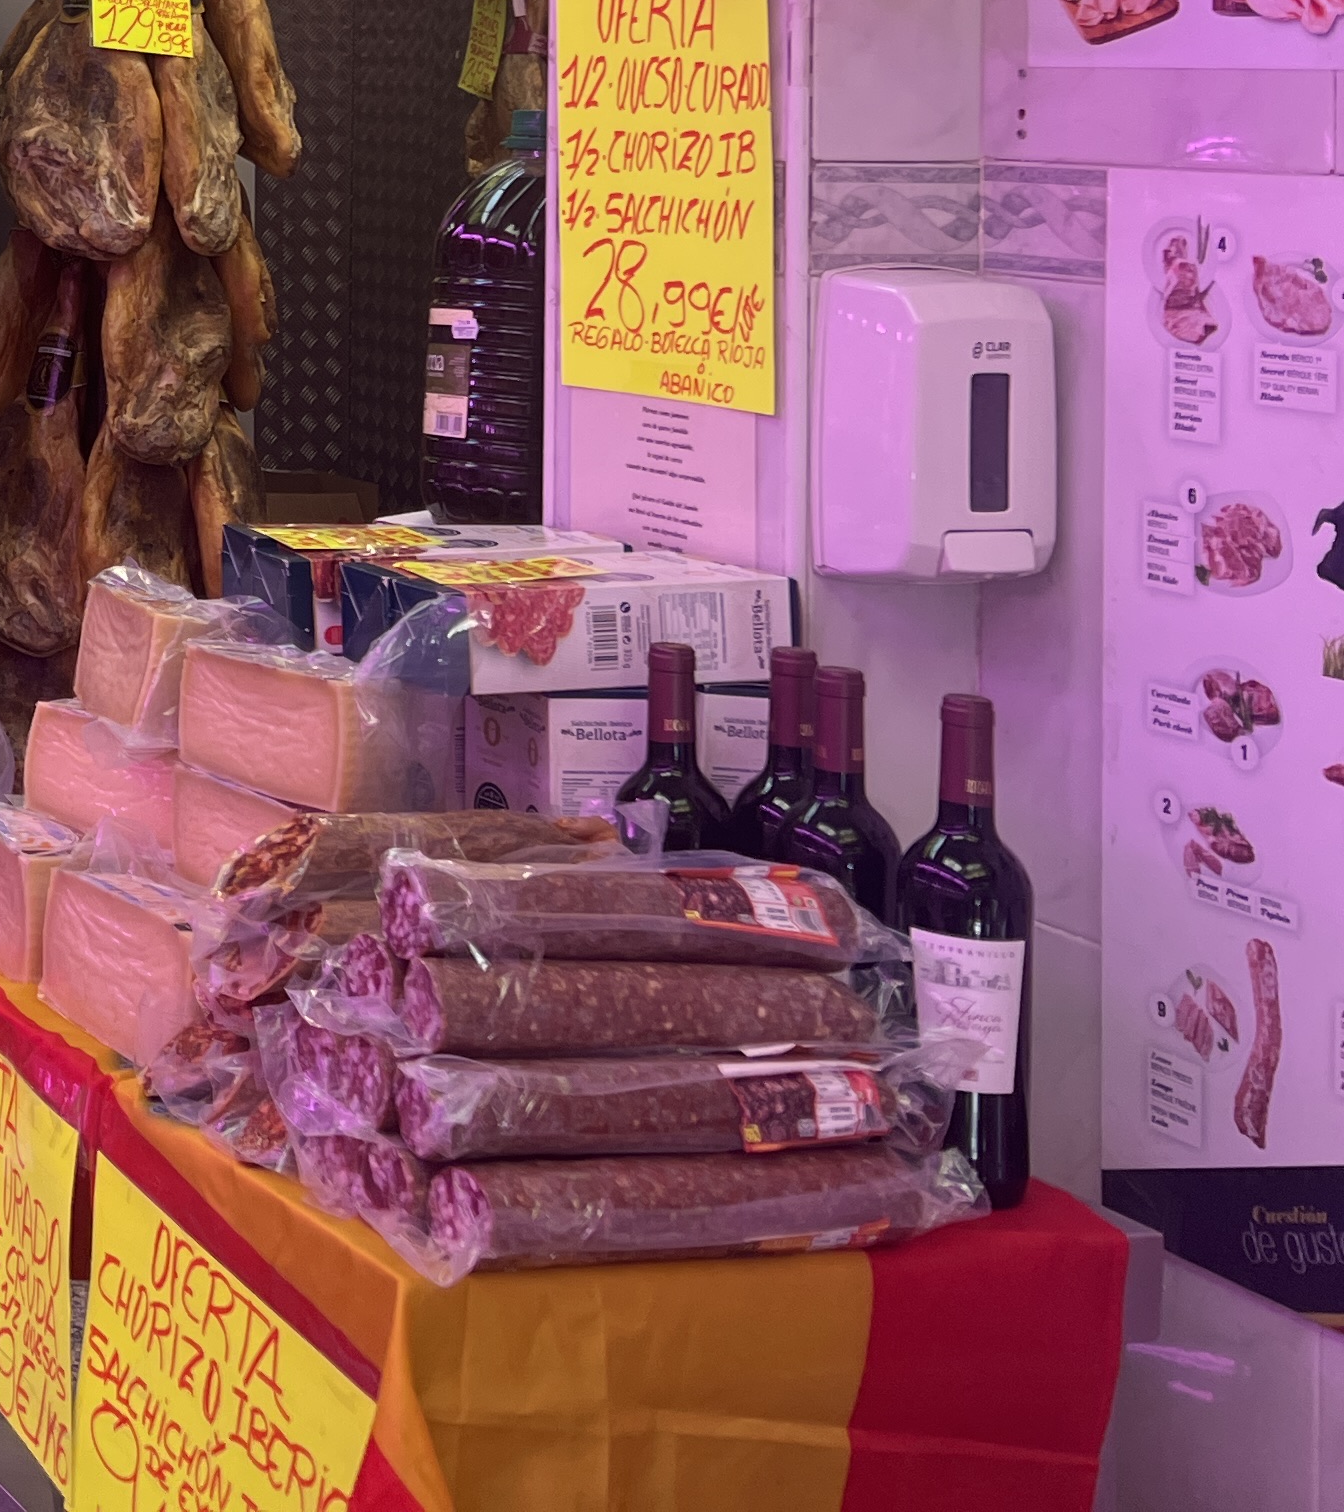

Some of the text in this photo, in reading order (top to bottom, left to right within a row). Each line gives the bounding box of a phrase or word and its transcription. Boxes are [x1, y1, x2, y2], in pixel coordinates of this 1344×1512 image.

[716, 130, 757, 178] IB
[1217, 236, 1227, 253] 4
[717, 335, 766, 370] RIOJA
[1187, 487, 1197, 505] 6
[575, 727, 627, 742] Bellota
[1163, 797, 1172, 815] 2
[1157, 1001, 1166, 1018] 9
[1243, 1222, 1280, 1266] de
[7, 1246, 58, 1358] CRUDA
[97, 1251, 221, 1424] CHORIZO
[151, 1219, 293, 1422] OFERTA
